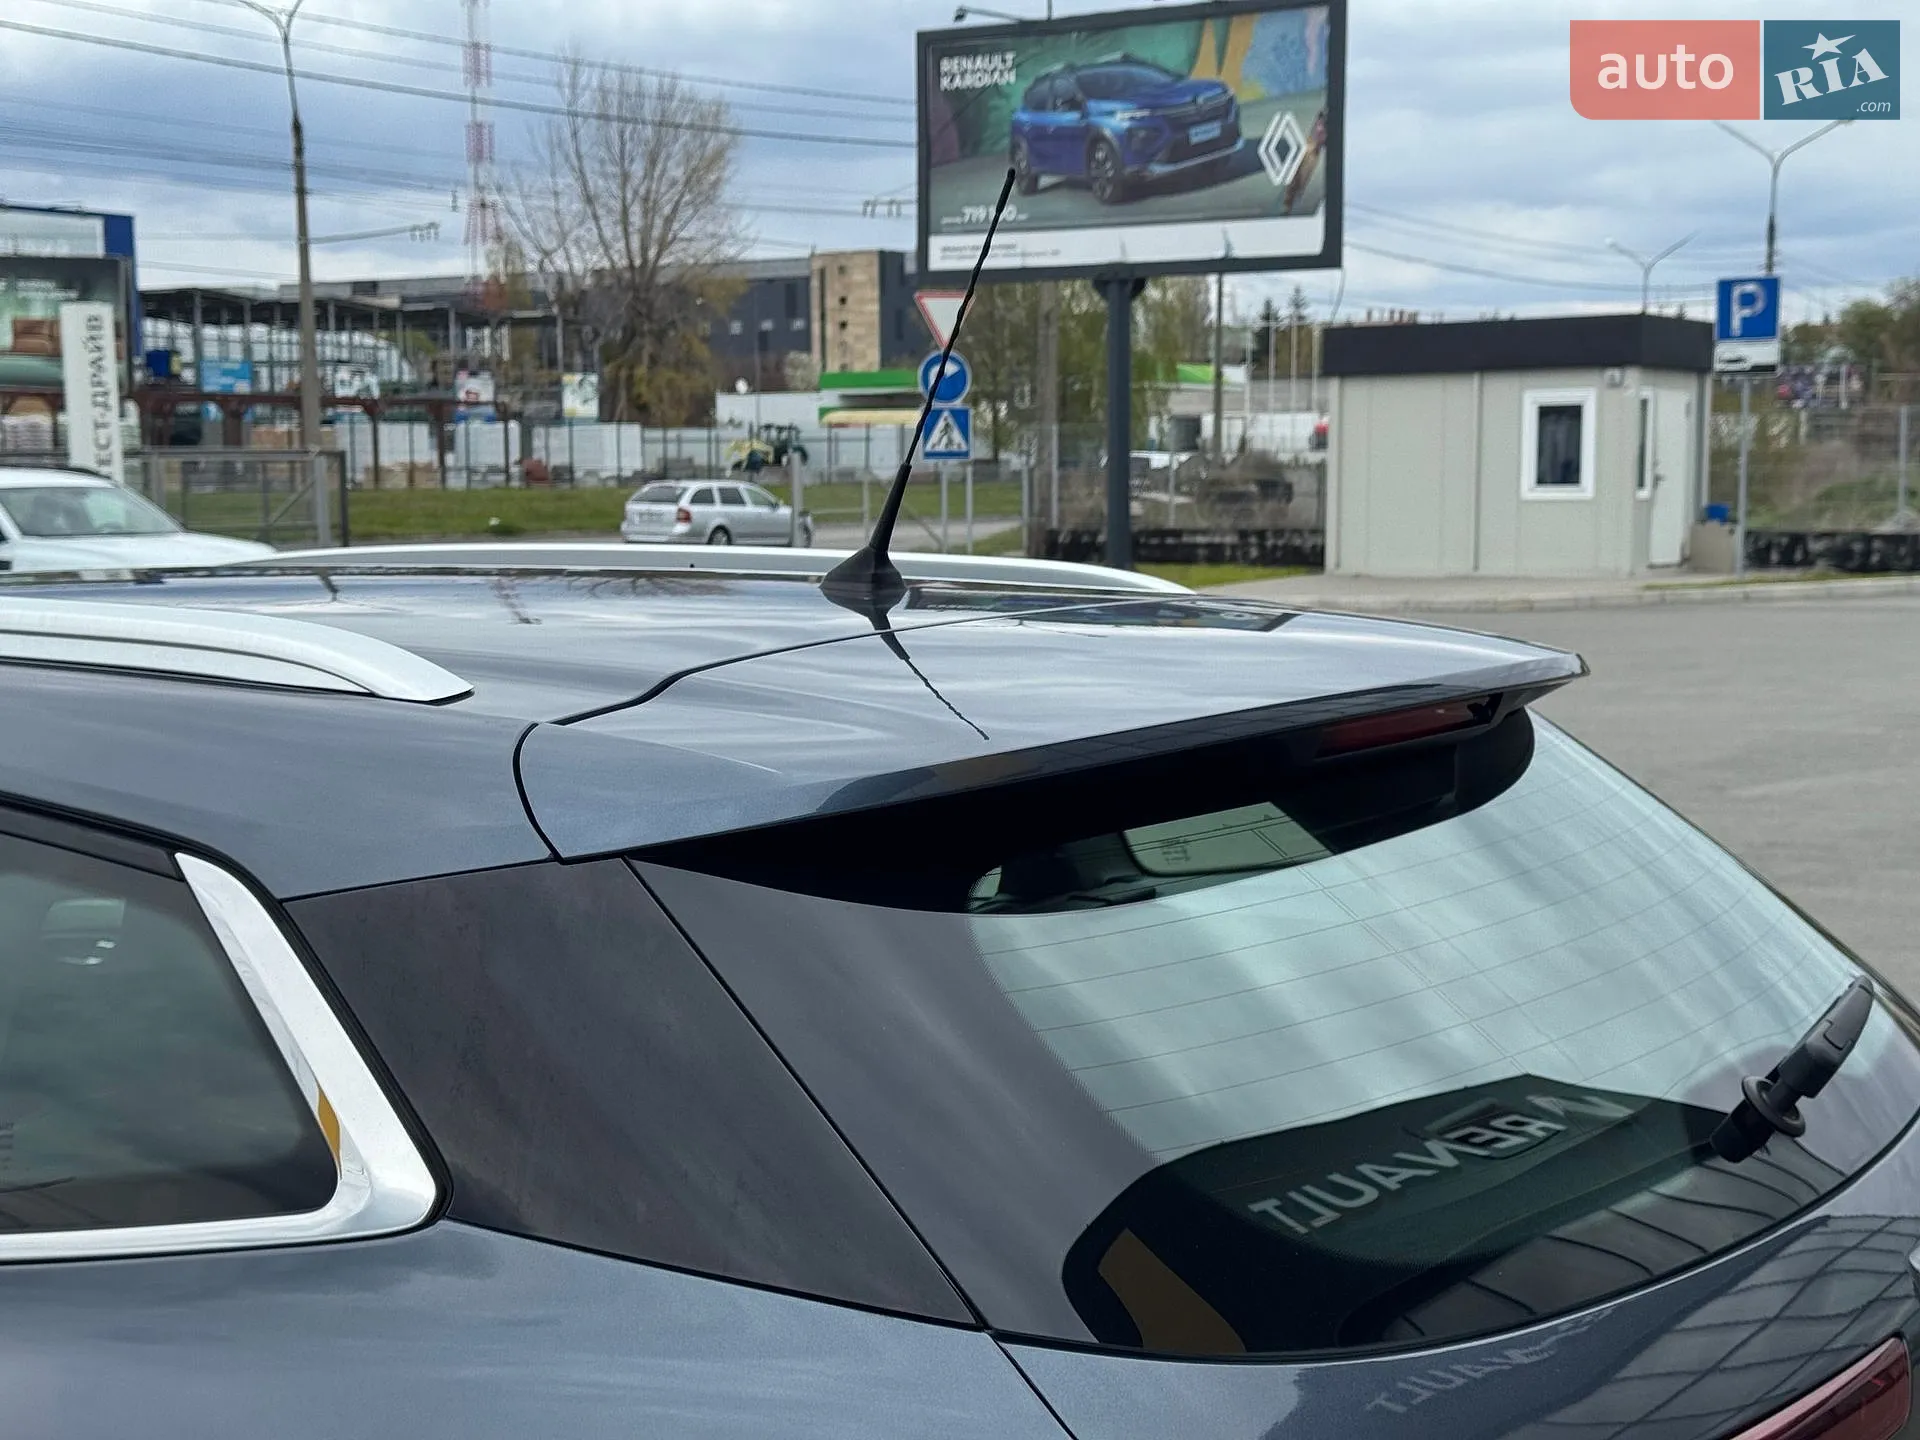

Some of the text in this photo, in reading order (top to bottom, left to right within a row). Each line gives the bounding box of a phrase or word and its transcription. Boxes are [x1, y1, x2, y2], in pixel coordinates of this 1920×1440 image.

[940, 51, 1016, 75] RENAULT
[1730, 283, 1766, 337] P
[83, 313, 113, 477] ЕСТ-ДРАЙВ
